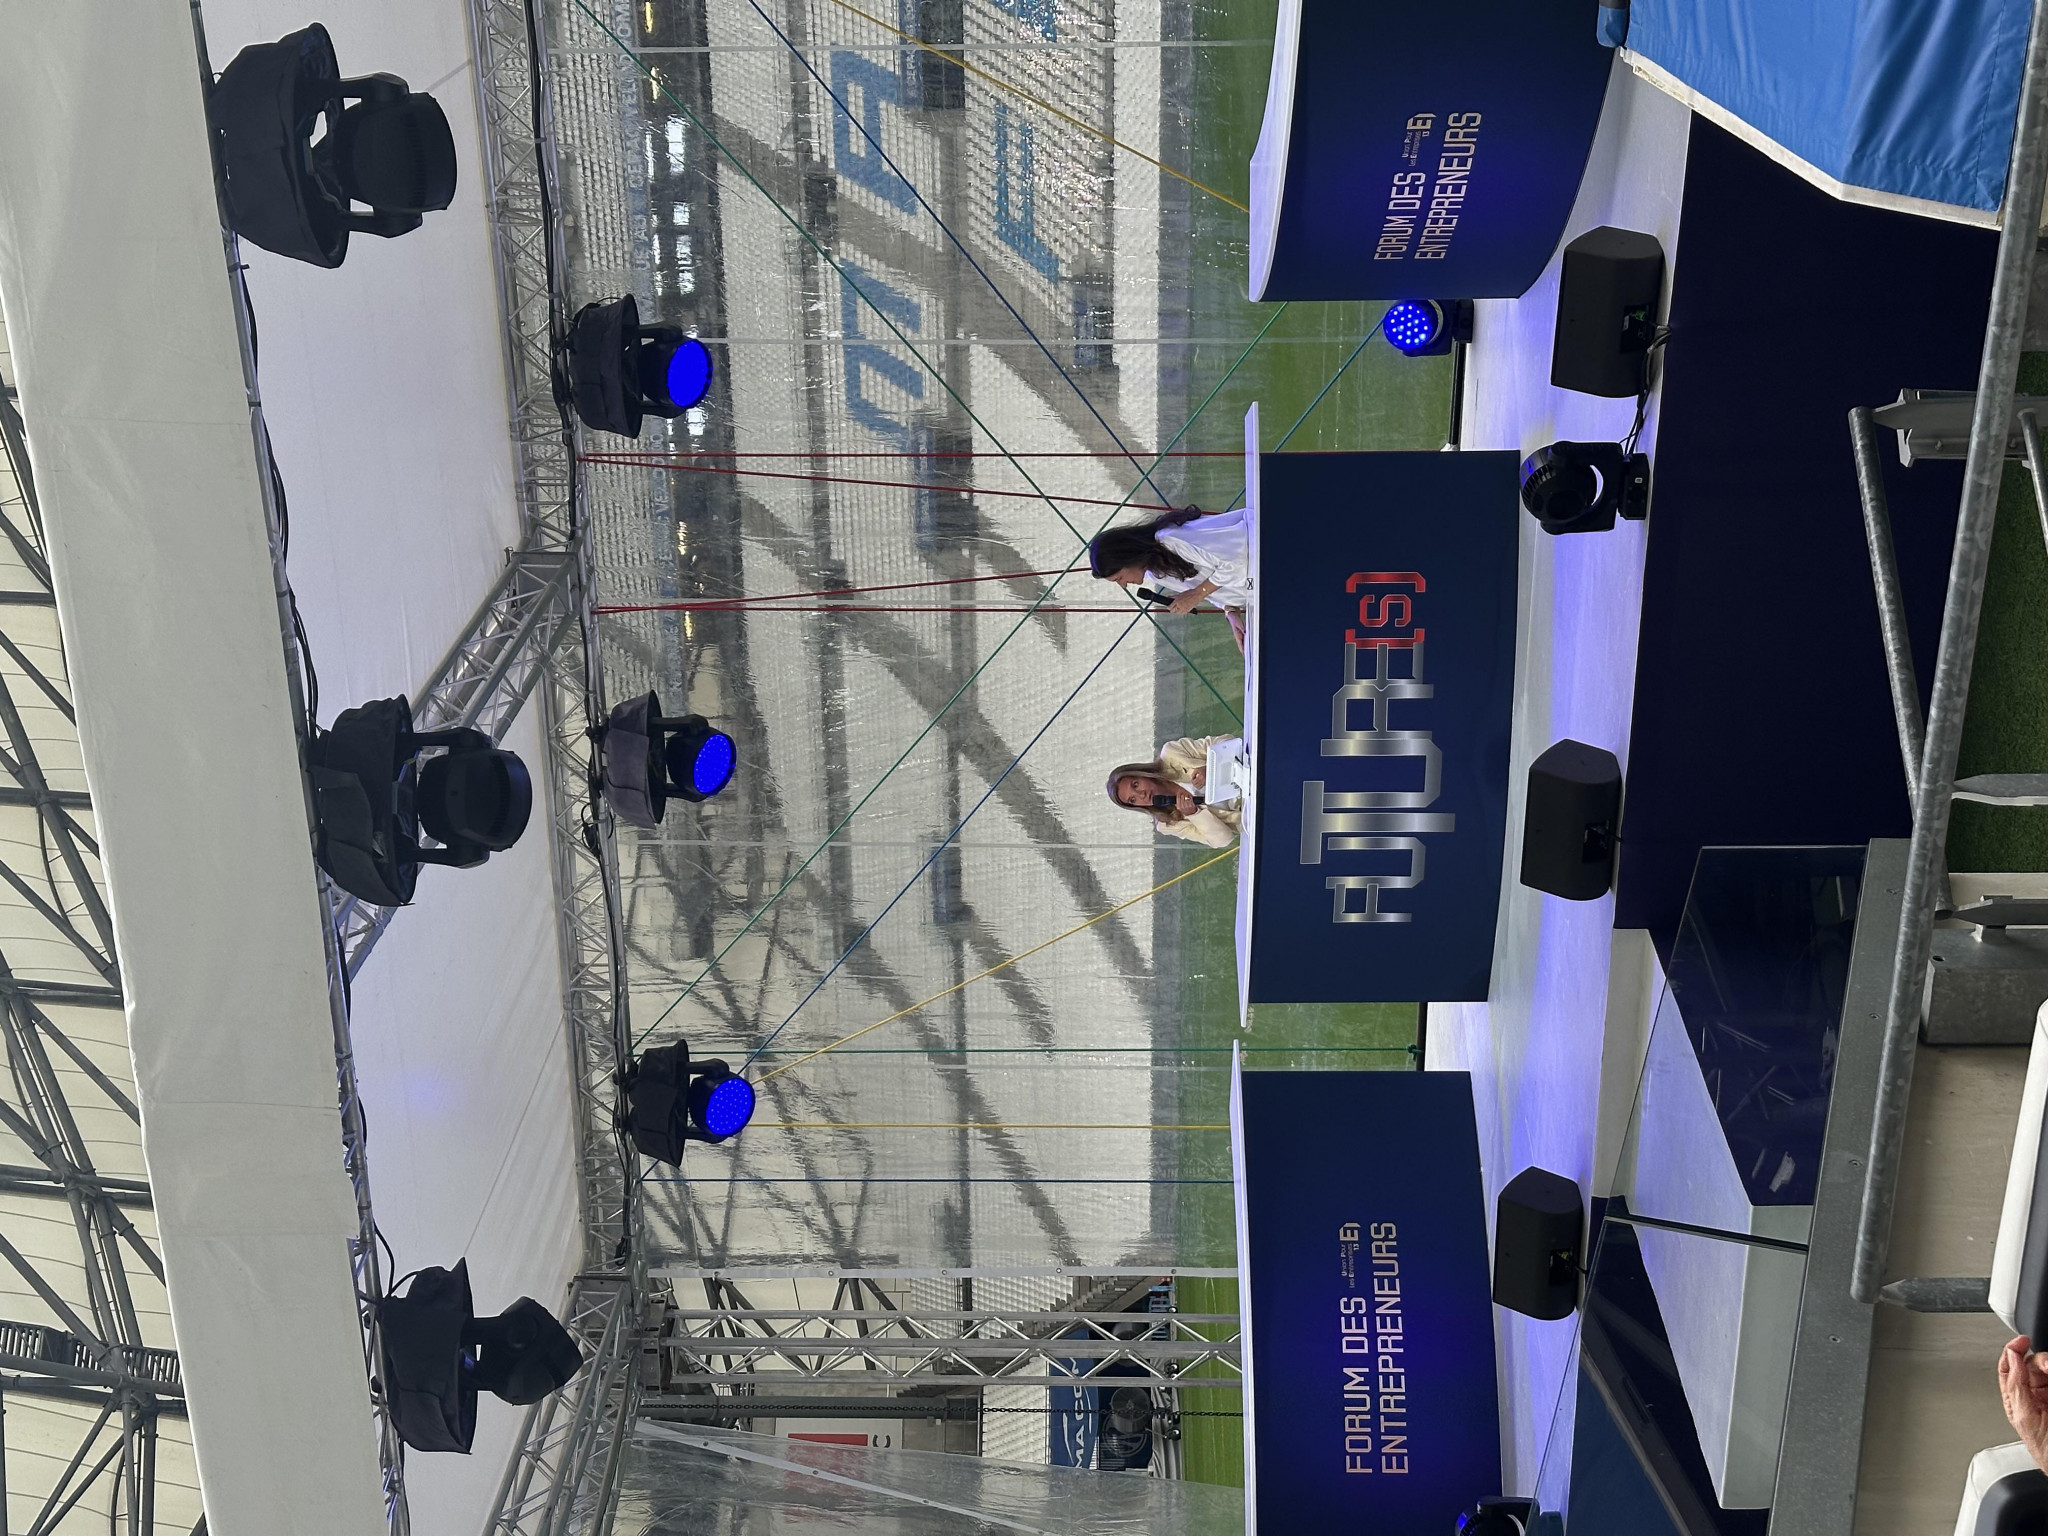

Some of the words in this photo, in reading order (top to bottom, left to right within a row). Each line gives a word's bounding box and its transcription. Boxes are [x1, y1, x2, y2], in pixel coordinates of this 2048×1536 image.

[1388, 172, 1426, 210] DES
[1414, 112, 1482, 260] ENTREPRENEURS
[1374, 216, 1417, 260] FORUM
[1353, 1243, 1359, 1251] 13
[1339, 1297, 1369, 1354] DES
[1370, 1222, 1408, 1474] ENTREPRENEURS
[1342, 1368, 1372, 1474] FORUM
